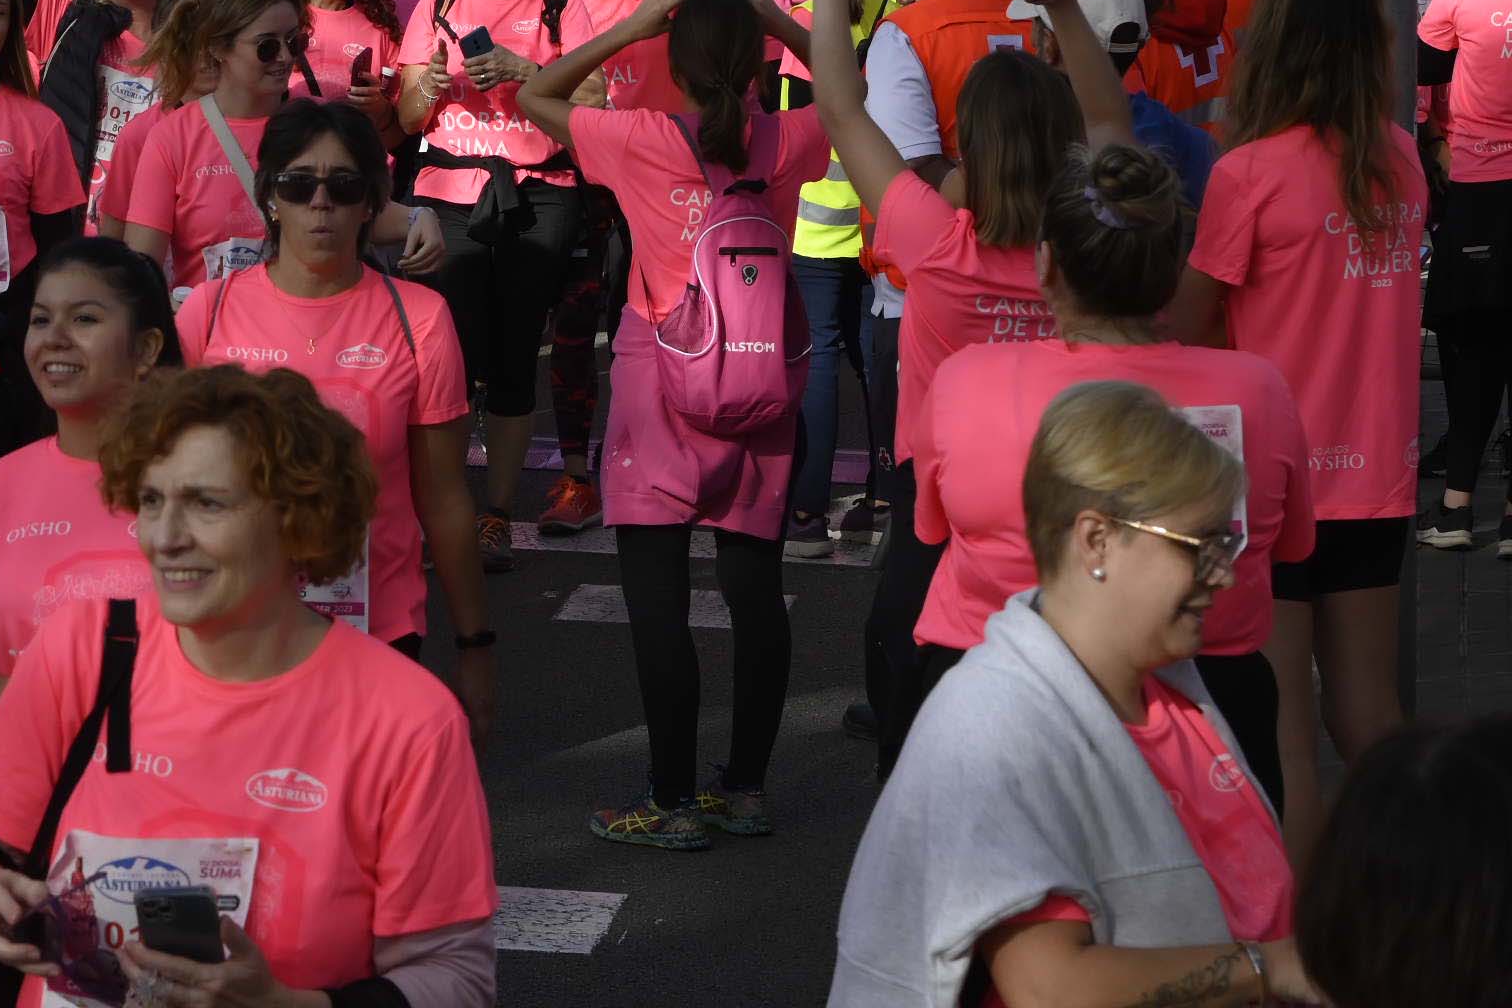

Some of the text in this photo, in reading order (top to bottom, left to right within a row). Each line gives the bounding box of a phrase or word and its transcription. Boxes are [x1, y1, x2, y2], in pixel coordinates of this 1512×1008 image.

[443, 111, 535, 133] DORSAL
[1343, 251, 1414, 281] MUJER
[1370, 279, 1393, 288] 2023
[993, 316, 1027, 337] DE
[226, 345, 288, 363] OYSHO
[723, 341, 776, 354] ALSTOM
[338, 353, 384, 365] ASTURIANA
[6, 519, 73, 545] OYSHO
[253, 777, 326, 806] ASTURIANA
[199, 867, 242, 879] SUMA
